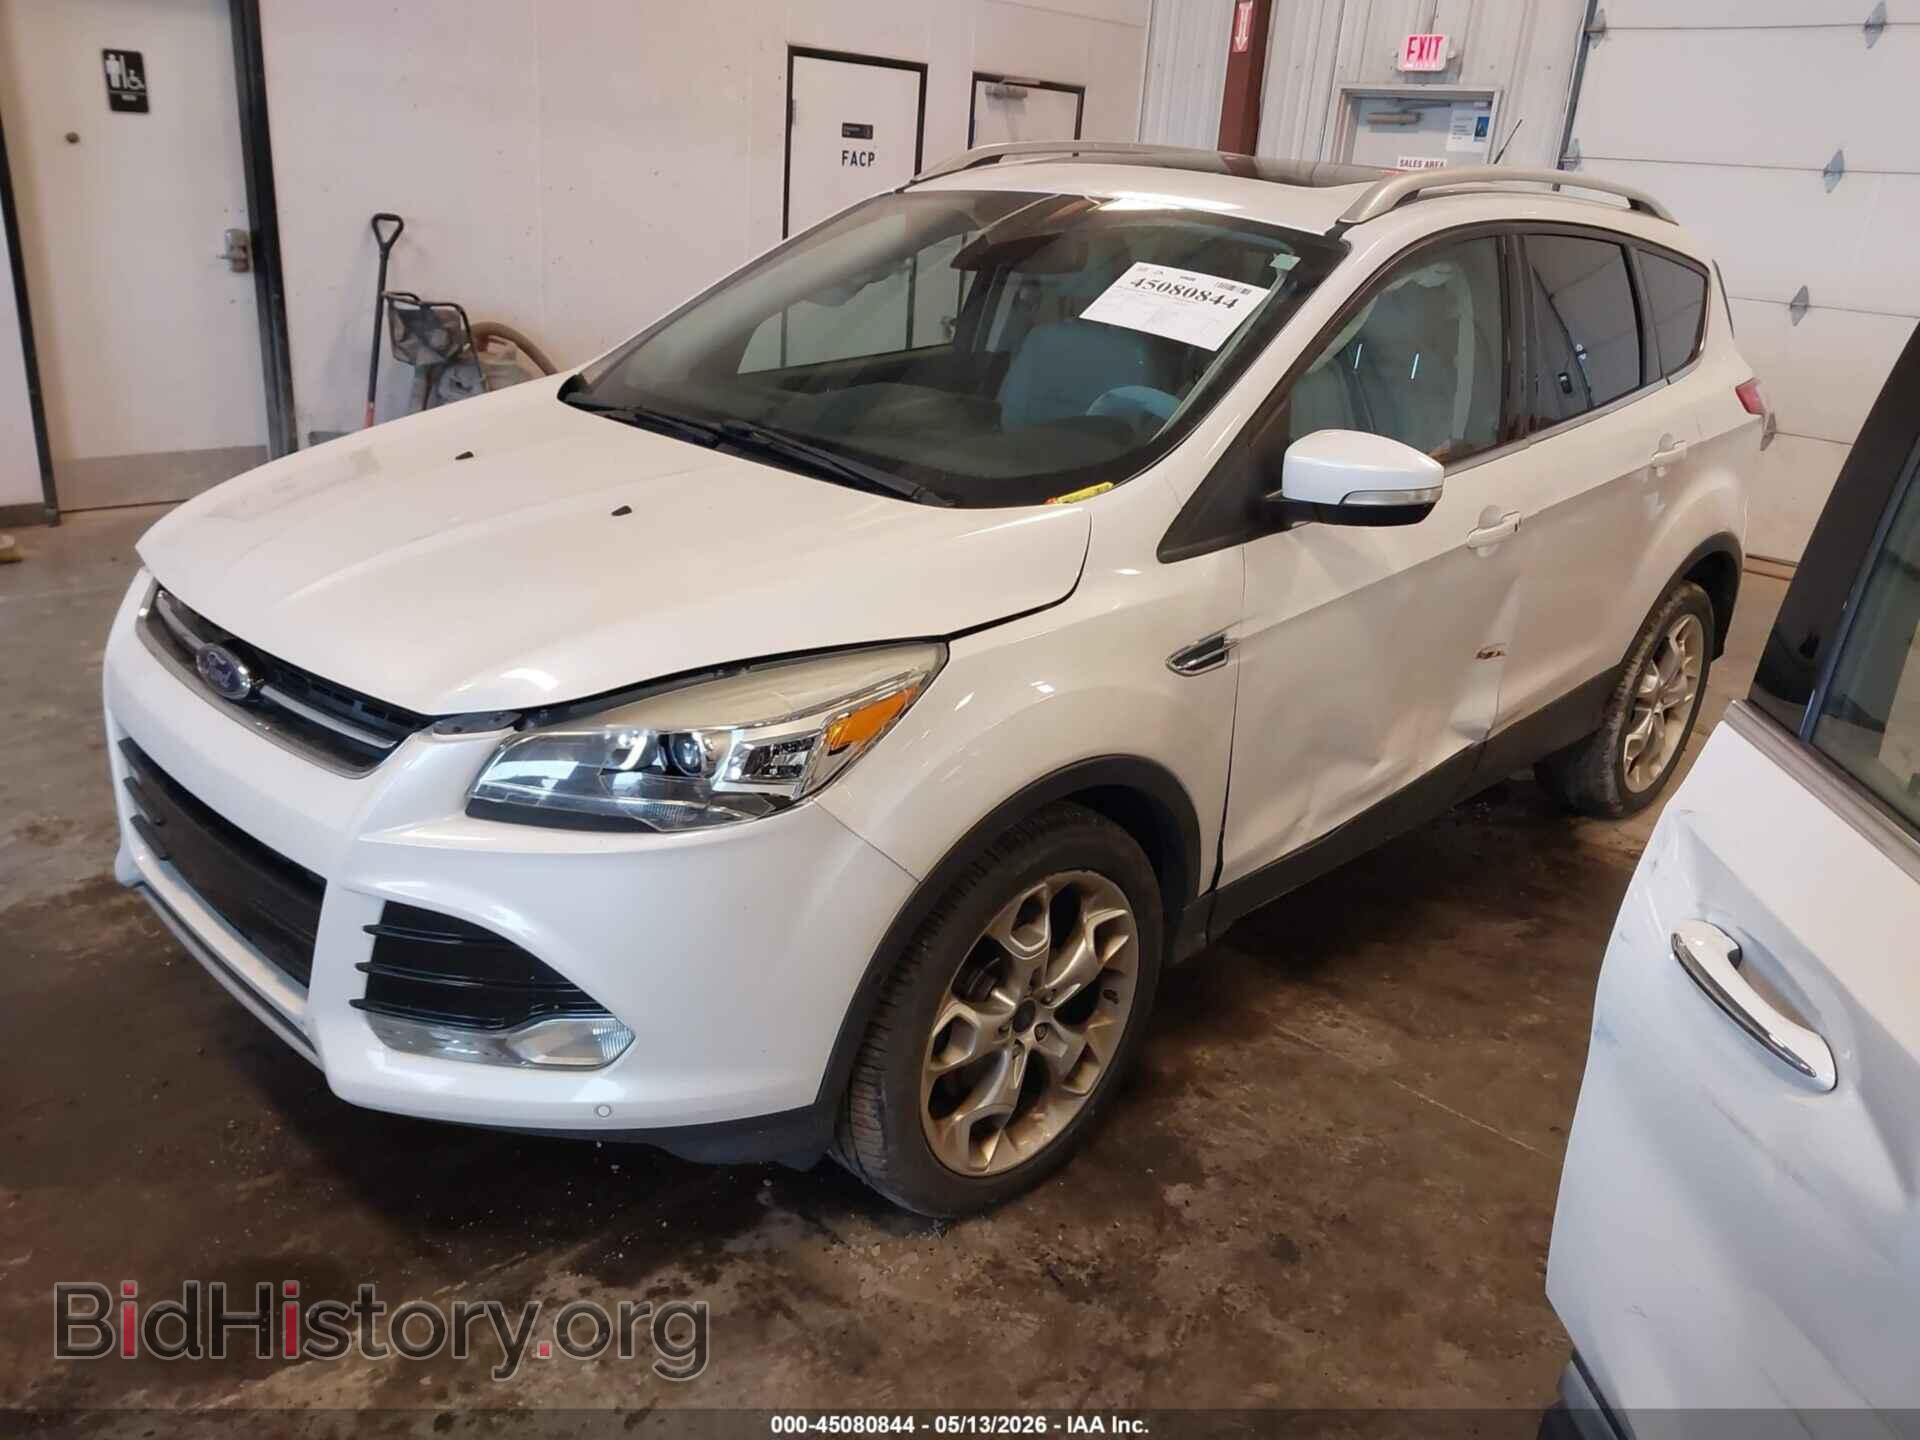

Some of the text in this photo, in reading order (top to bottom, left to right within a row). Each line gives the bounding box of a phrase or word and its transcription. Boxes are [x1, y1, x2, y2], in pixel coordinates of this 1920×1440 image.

[1406, 36, 1443, 63] EXIT
[841, 150, 875, 167] FACP
[1399, 159, 1422, 168] SALES
[1130, 277, 1239, 309] 45080844
